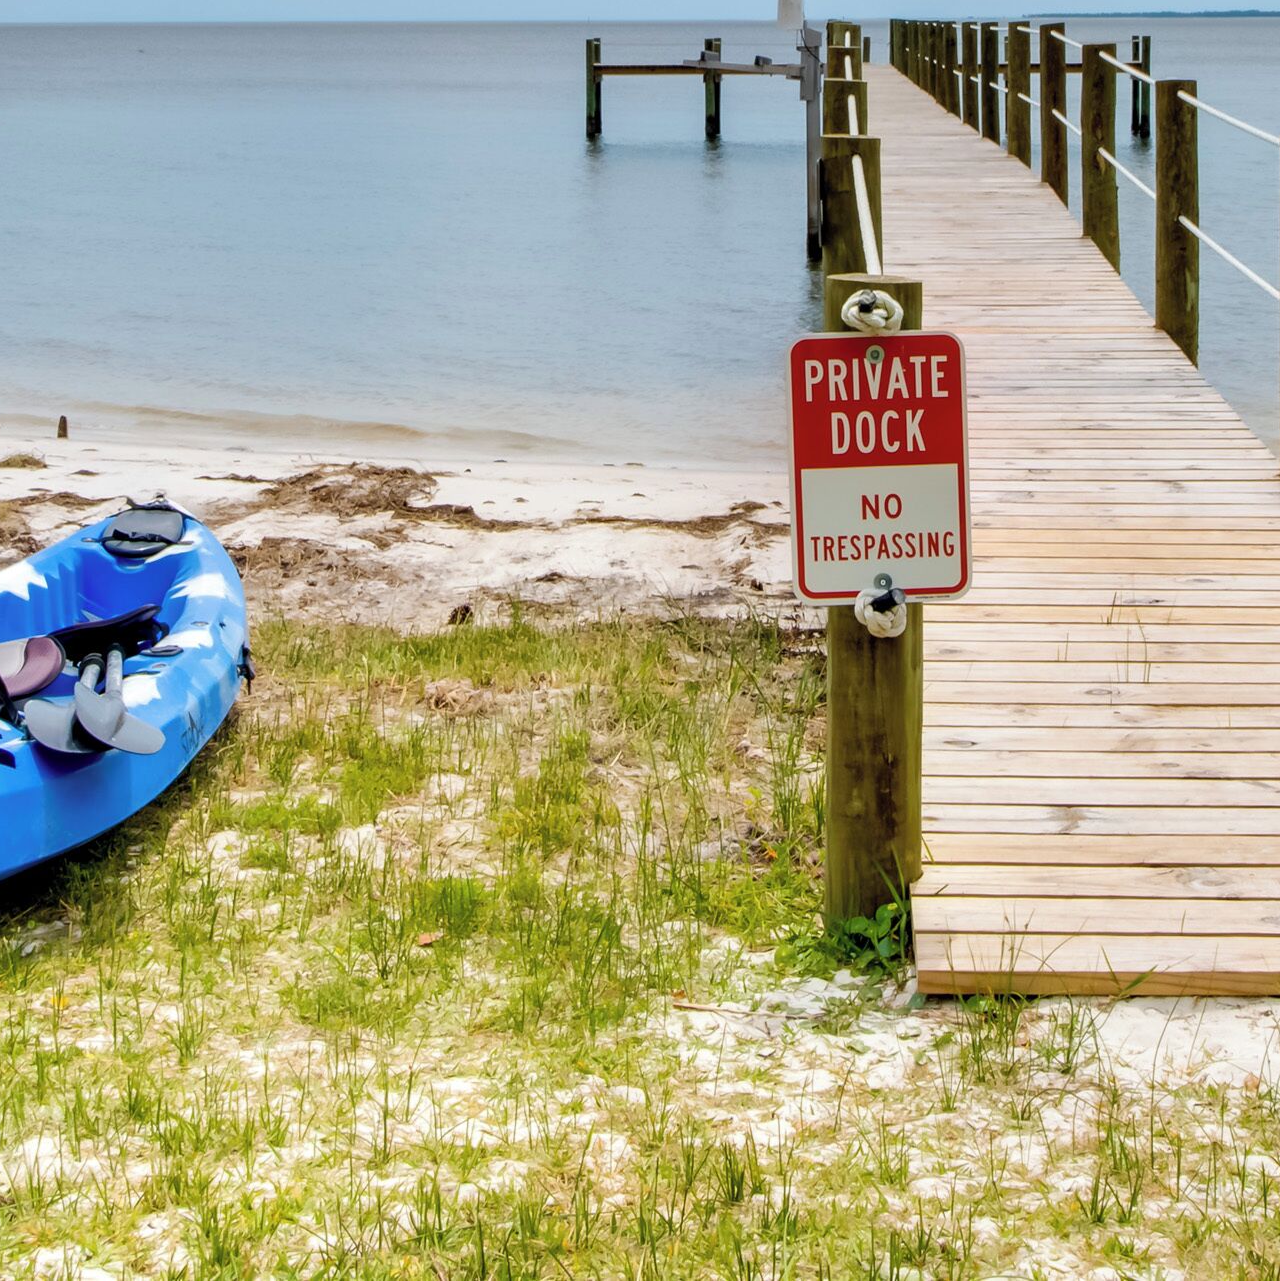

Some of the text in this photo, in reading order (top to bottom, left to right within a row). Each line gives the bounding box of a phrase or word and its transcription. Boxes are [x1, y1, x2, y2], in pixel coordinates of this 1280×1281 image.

[804, 355, 949, 402] PRIVATE
[830, 409, 926, 455] DOCK
[860, 493, 903, 520] NO
[810, 531, 955, 562] TRESPASSING
